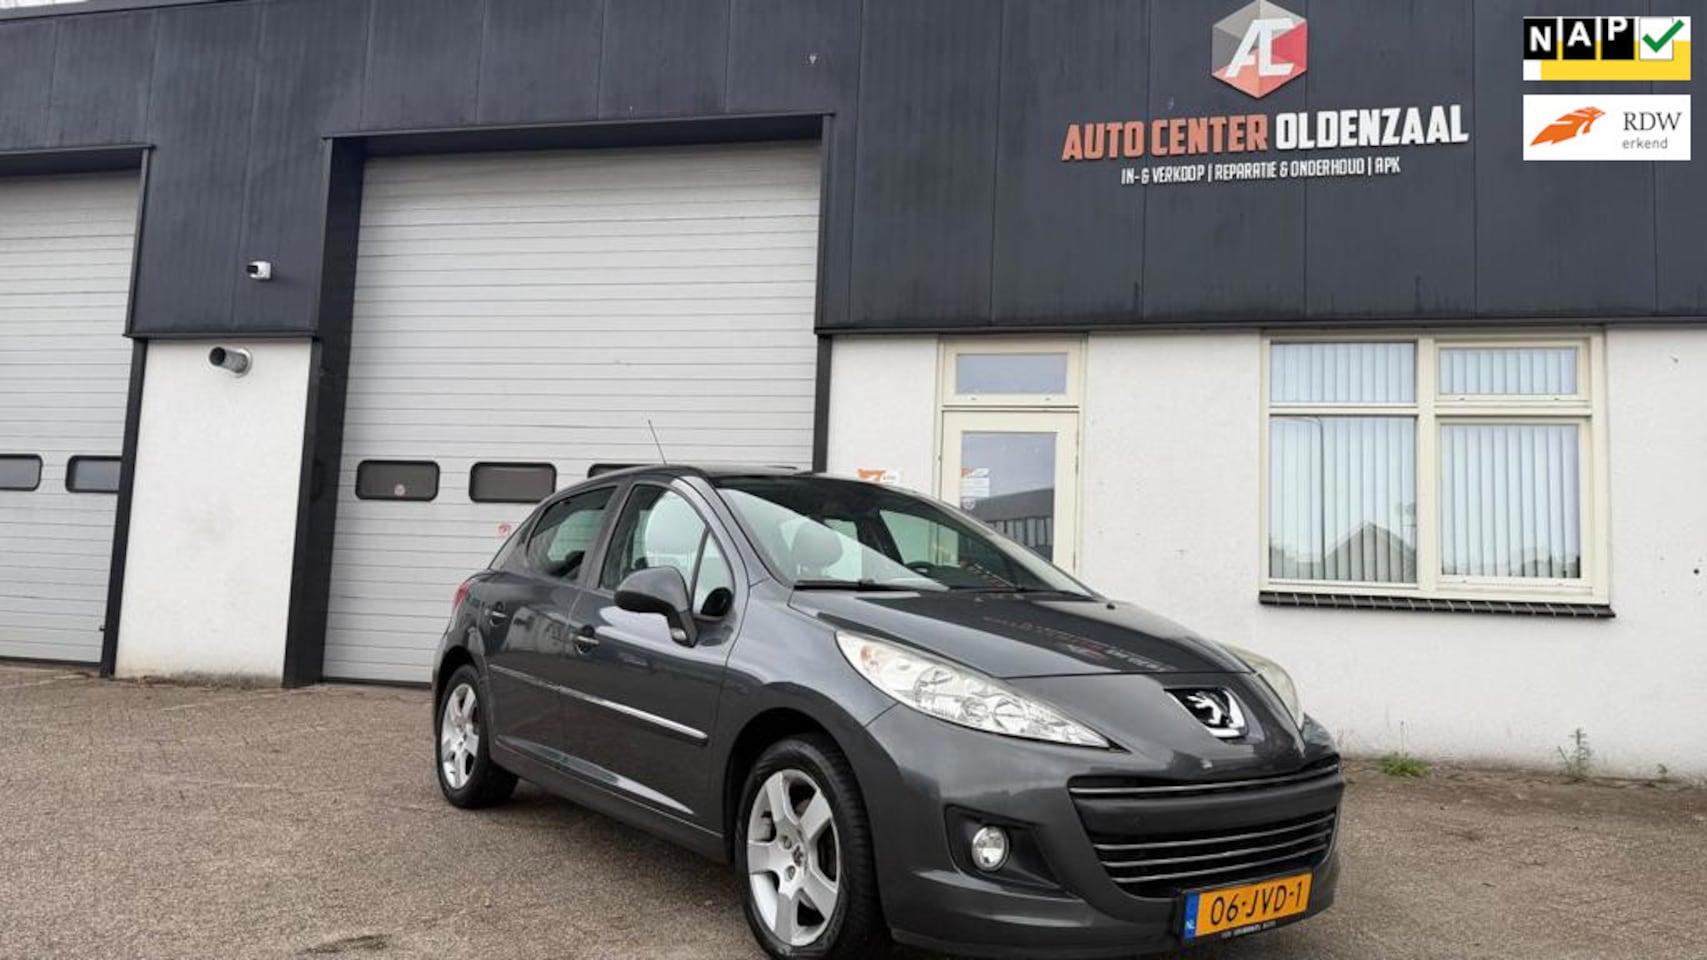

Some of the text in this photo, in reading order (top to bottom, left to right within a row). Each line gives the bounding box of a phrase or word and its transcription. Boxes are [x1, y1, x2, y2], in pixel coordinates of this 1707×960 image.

[1061, 104, 1470, 161] AUTO CENTER OLDENZAAL
[1152, 164, 1204, 184] VERKOOP
[1214, 161, 1277, 181] REPARATIE
[1290, 157, 1365, 177] ONDERHOUD
[1375, 157, 1401, 175] APK
[1210, 881, 1303, 926] 06-JVD-1
